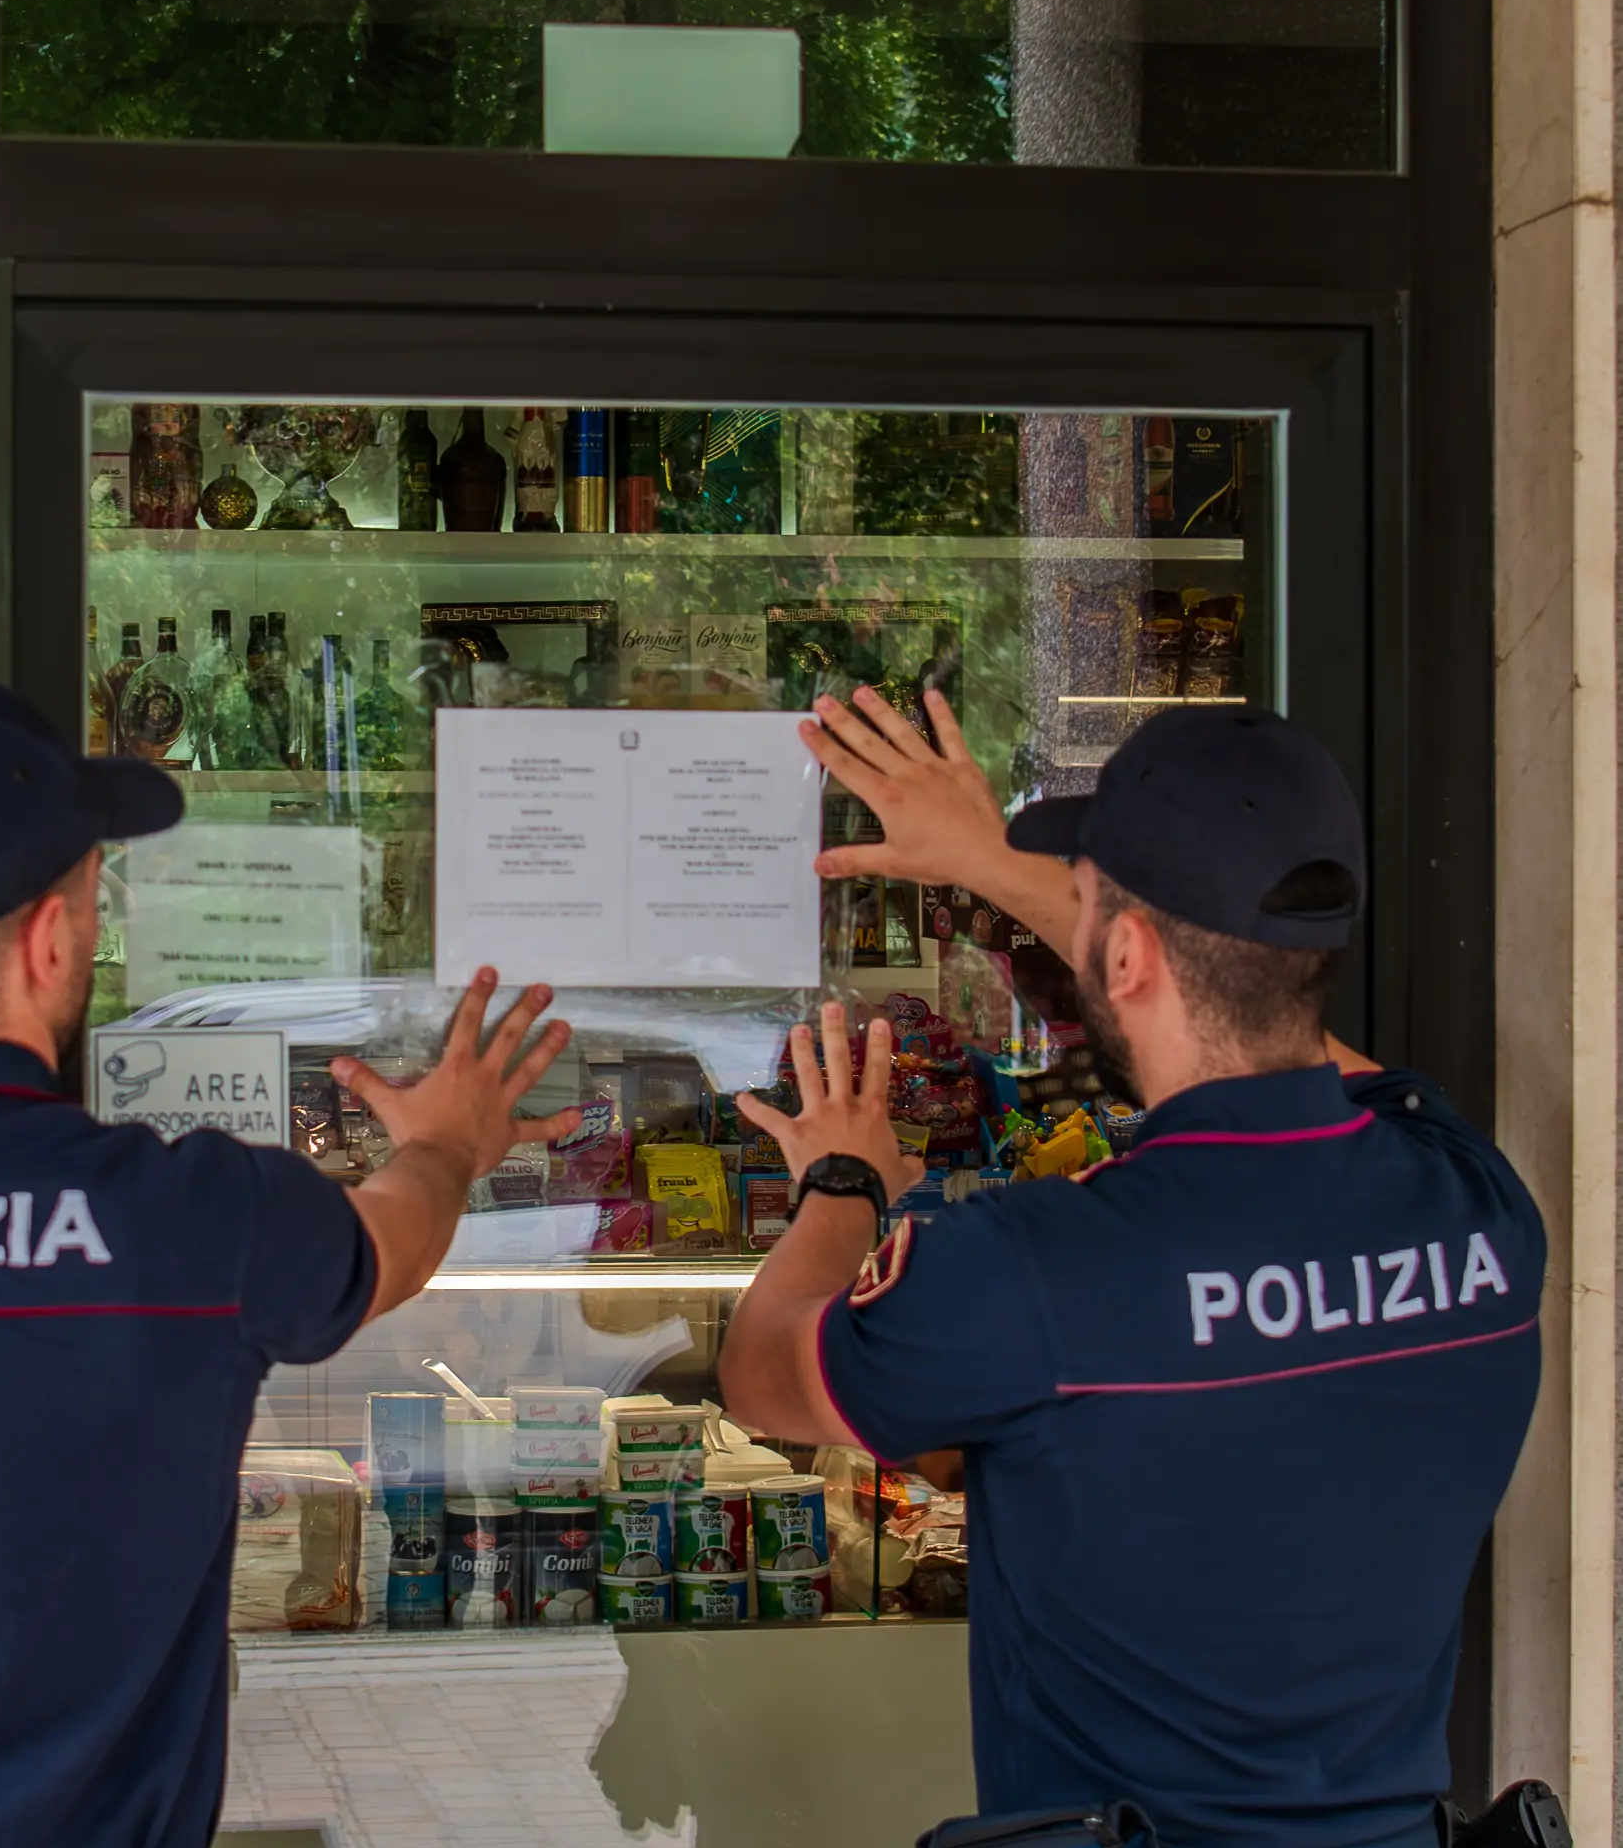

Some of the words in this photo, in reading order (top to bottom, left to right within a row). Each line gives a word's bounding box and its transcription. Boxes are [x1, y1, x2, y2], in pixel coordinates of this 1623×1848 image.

[621, 628, 688, 652] Bonjour
[695, 625, 762, 652] Bonjour
[185, 1073, 270, 1102] AREA
[583, 1105, 609, 1118] AZY
[495, 1164, 533, 1175] HELIO
[657, 1175, 697, 1188] fruubi
[1186, 1231, 1509, 1345] POLIZIA
[452, 1554, 511, 1574] Combi
[543, 1553, 594, 1572] Comb
